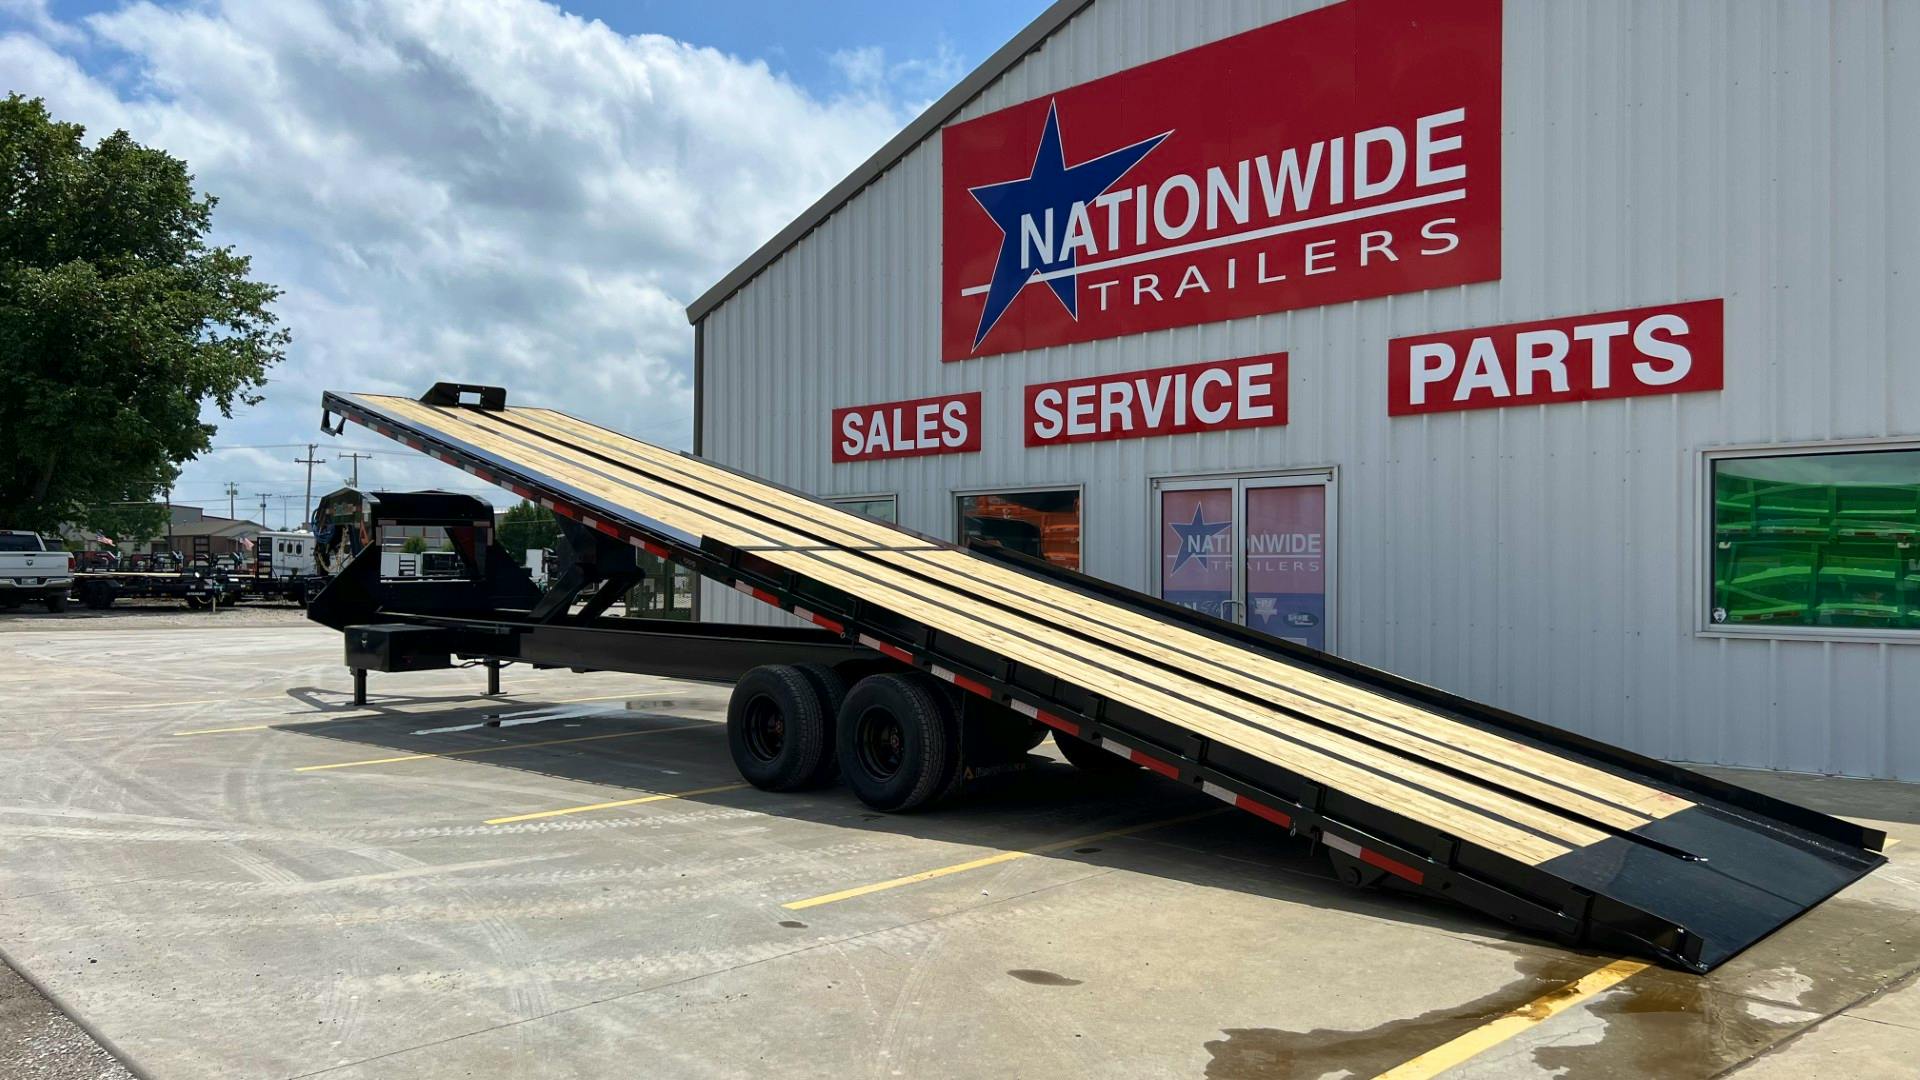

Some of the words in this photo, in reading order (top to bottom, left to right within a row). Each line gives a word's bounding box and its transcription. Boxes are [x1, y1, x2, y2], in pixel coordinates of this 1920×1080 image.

[1020, 107, 1467, 269] NATIONWIDE
[1088, 217, 1460, 311] TRAILERS
[1409, 313, 1692, 405] PARTS
[841, 400, 968, 457] SALES
[1033, 362, 1274, 439] SERVICE
[1187, 533, 1321, 553] NATINWIDE
[1211, 560, 1320, 572] TRILERS
